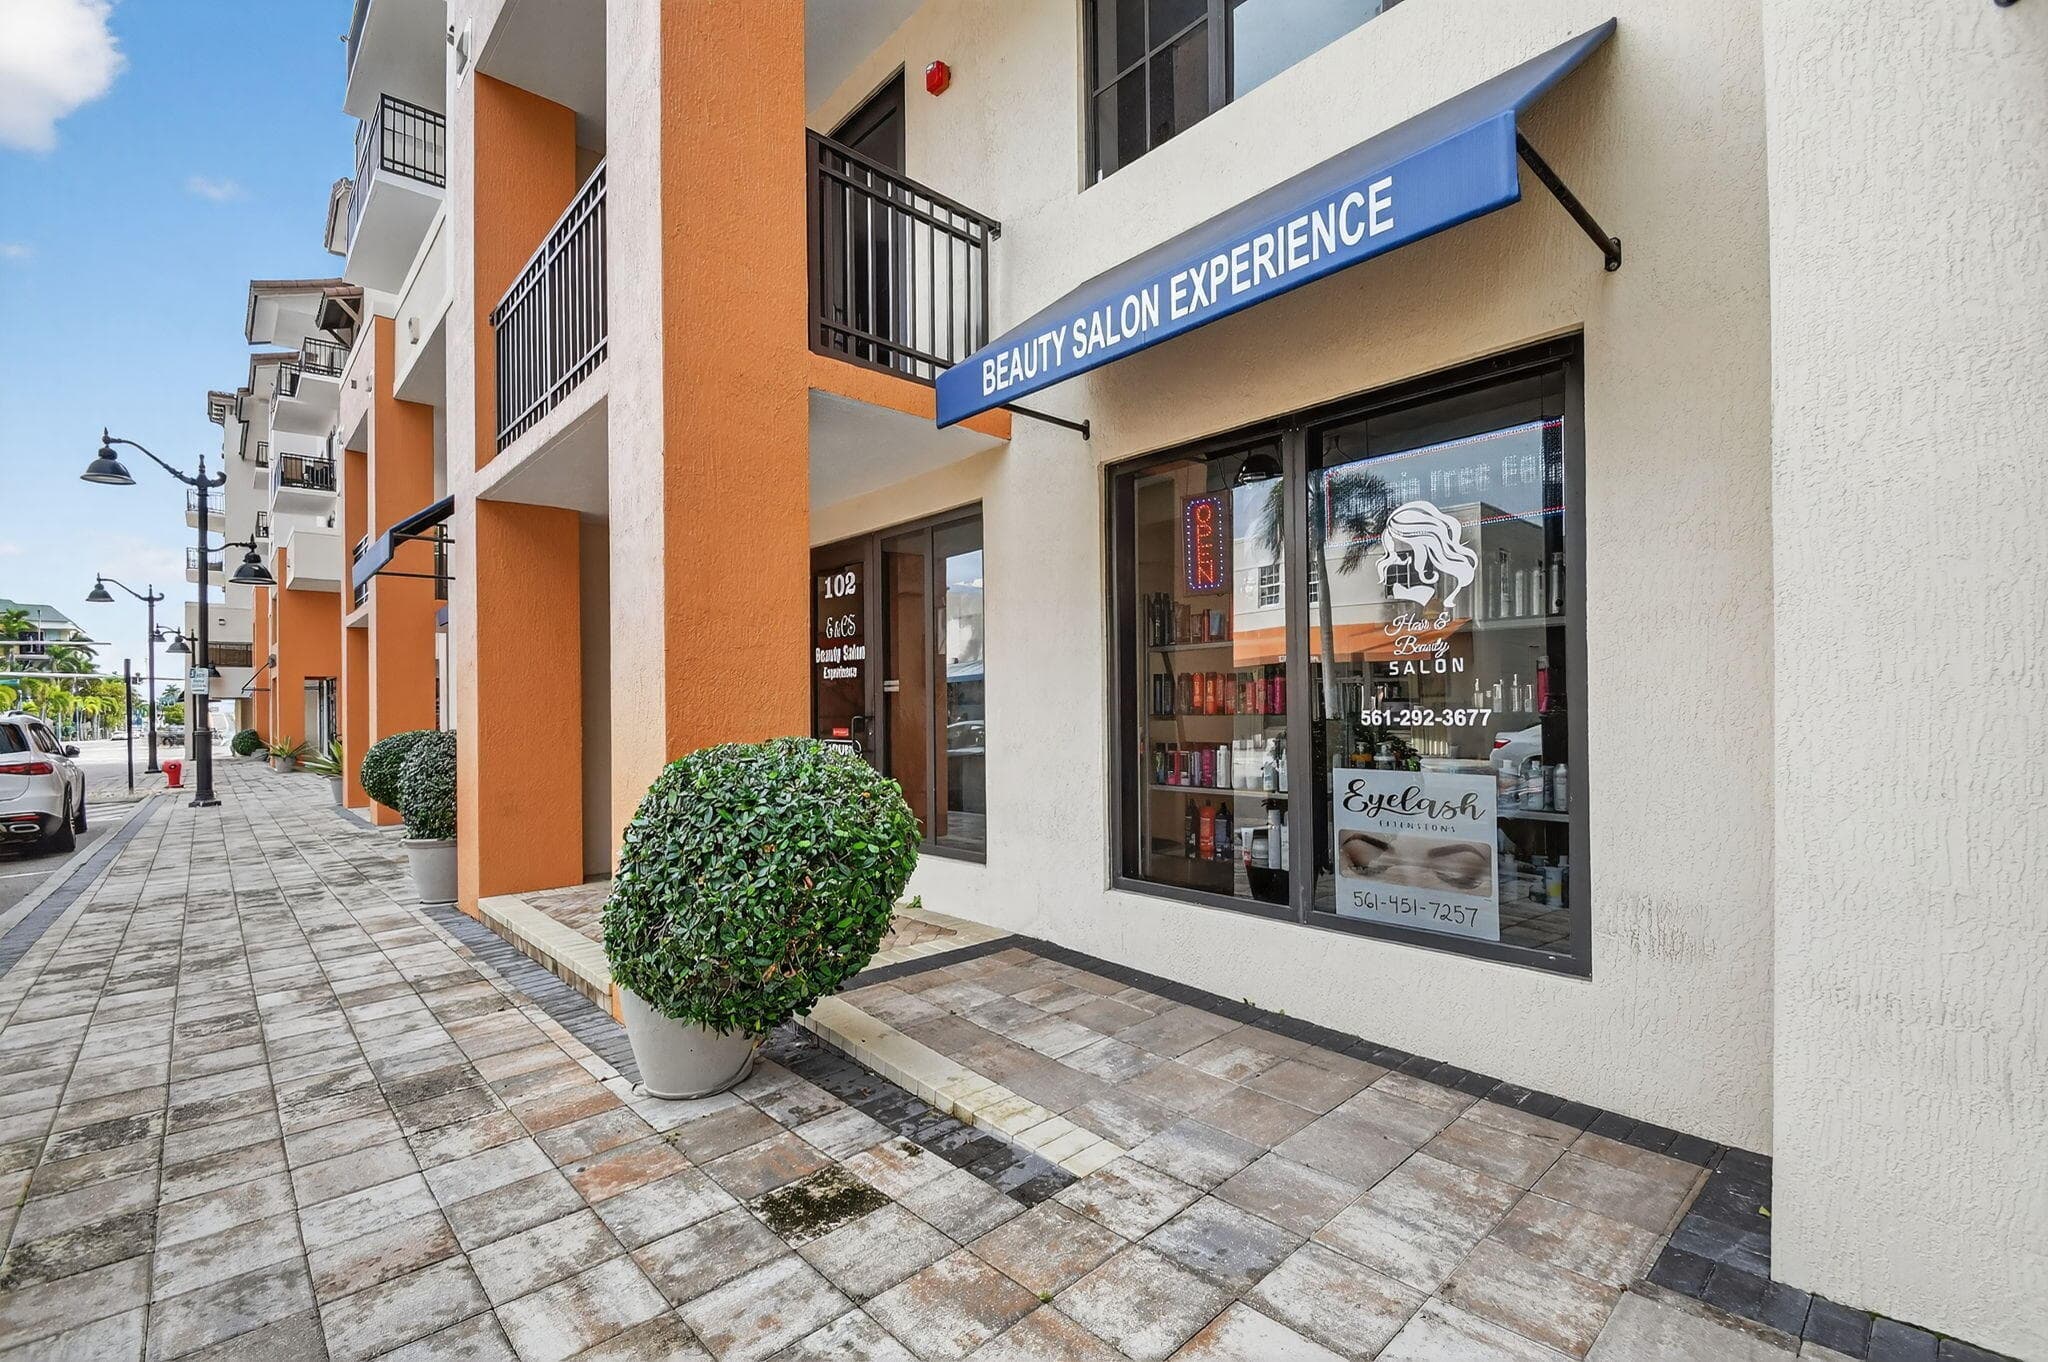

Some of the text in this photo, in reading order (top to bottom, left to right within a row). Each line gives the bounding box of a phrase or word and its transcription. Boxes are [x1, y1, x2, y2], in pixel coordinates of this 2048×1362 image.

[983, 176, 1394, 396] BEAUTY SALON EXPERIENCE
[1196, 503, 1214, 585] OPEN
[824, 571, 856, 599] 102
[1384, 611, 1452, 637] Hair &
[815, 644, 866, 664] Beauty Salon
[1393, 635, 1450, 659] Beauty
[1389, 657, 1464, 676] SALON
[1361, 708, 1492, 727] 561-292-3677
[1342, 778, 1486, 821] Eyelash
[1379, 820, 1456, 833] EXTENSIONS
[1353, 891, 1478, 928] 561-451-7257
